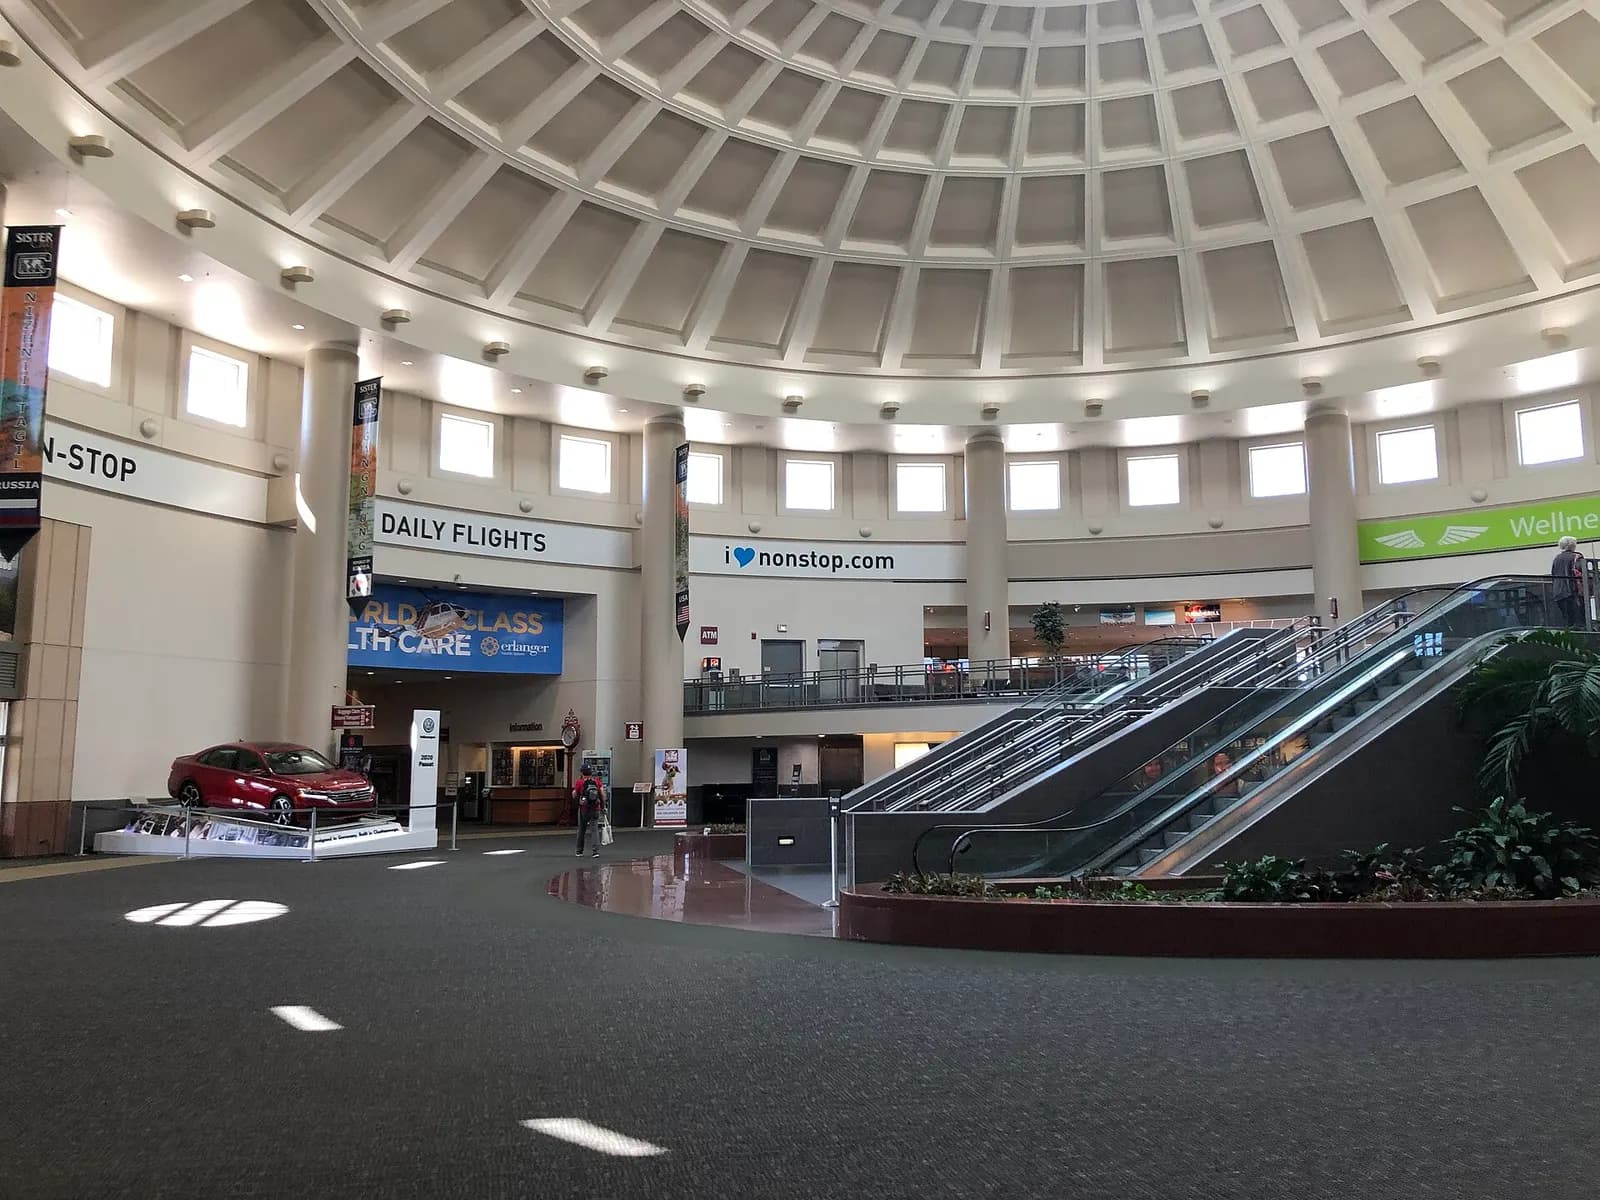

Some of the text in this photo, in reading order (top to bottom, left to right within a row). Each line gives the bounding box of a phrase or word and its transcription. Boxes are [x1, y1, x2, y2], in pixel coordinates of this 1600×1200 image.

[15, 232, 53, 243] SISTER
[13, 402, 27, 470] TAGIL
[381, 512, 546, 552] DAILY FLIGHTS
[1509, 511, 1599, 538] Wellne
[725, 546, 894, 573] i nonstop.com
[678, 594, 688, 603] USA
[349, 600, 545, 636] RLD CLASS
[348, 626, 472, 657] TH CARE
[501, 640, 550, 657] erlanger
[702, 631, 718, 640] ATM
